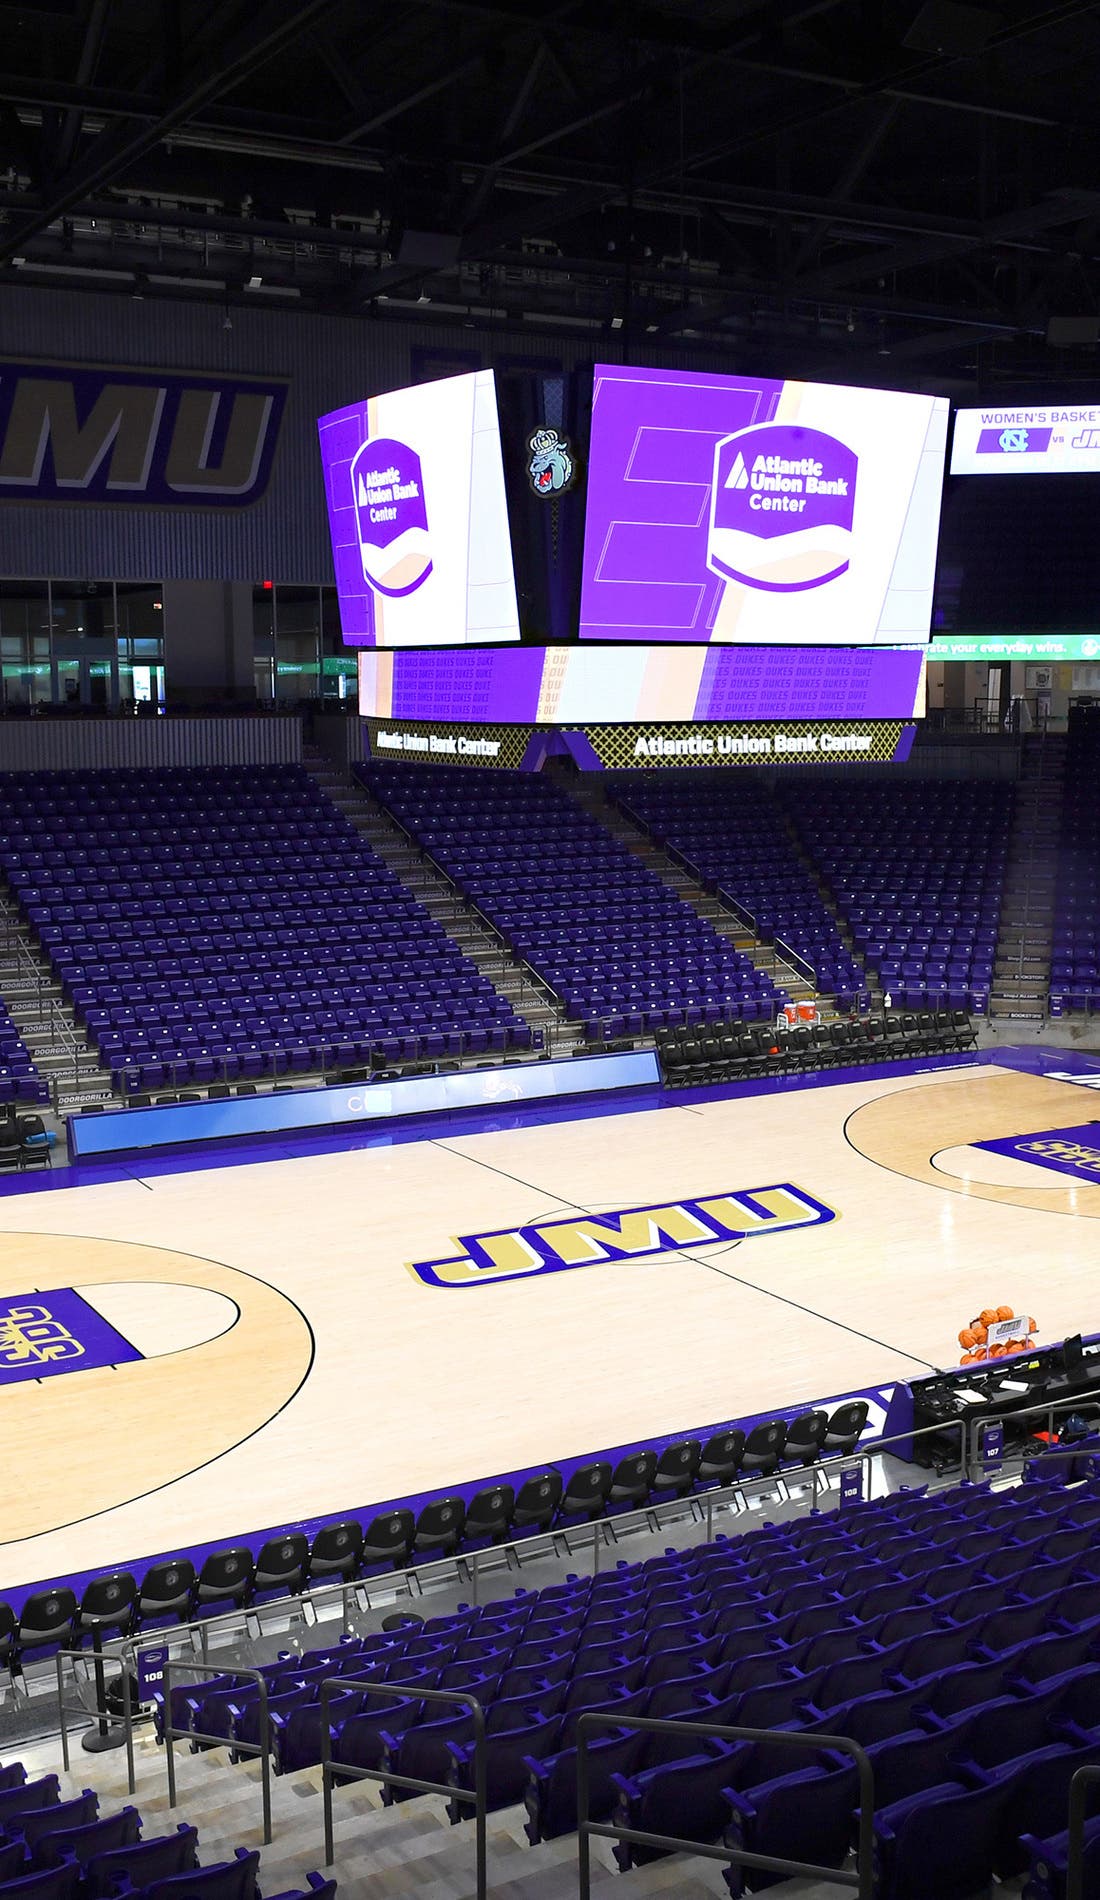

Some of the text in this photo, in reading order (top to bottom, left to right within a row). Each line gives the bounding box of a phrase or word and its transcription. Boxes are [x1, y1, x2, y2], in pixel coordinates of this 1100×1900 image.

[981, 410, 1100, 424] WOMEN'S BASKE
[0, 376, 274, 495] MU
[752, 455, 823, 476] Atlantic
[366, 467, 401, 489] Atlantic
[750, 472, 848, 496] Union Bank
[367, 480, 420, 506] Union Bank
[750, 493, 806, 512] Center
[370, 506, 397, 523] Center
[951, 645, 978, 655] your
[980, 642, 1033, 655] everyday
[1036, 642, 1067, 653] wins.
[735, 654, 765, 664] DUKES
[768, 654, 796, 664] DUKES
[799, 654, 825, 664] DUKES
[827, 654, 852, 664] DUKES
[732, 667, 762, 676] DUKES
[765, 667, 793, 676] DUKES
[796, 667, 822, 676] DUKES
[825, 667, 849, 676] DUKES
[730, 679, 760, 688] DUKES
[762, 679, 790, 688] DUKES
[794, 679, 820, 688] DUKES
[823, 679, 848, 688] DUKES
[728, 691, 756, 701] DUKES
[760, 691, 788, 701] DUKES
[791, 691, 818, 701] DUKES
[820, 691, 845, 701] DUKES
[725, 702, 754, 712] DUKES
[758, 702, 786, 712] DUKES
[789, 702, 815, 712] DUKES
[818, 702, 843, 712] DUKES
[429, 735, 457, 754] Bank
[458, 736, 500, 757] Center
[633, 733, 873, 756] Atlantic Union Bank Center
[1, 980, 51, 990] DOORGORILA
[58, 1092, 112, 1104] DOORGORILLA
[412, 1182, 838, 1289] JMU
[987, 1448, 999, 1457] 107
[144, 1671, 163, 1682] 108
